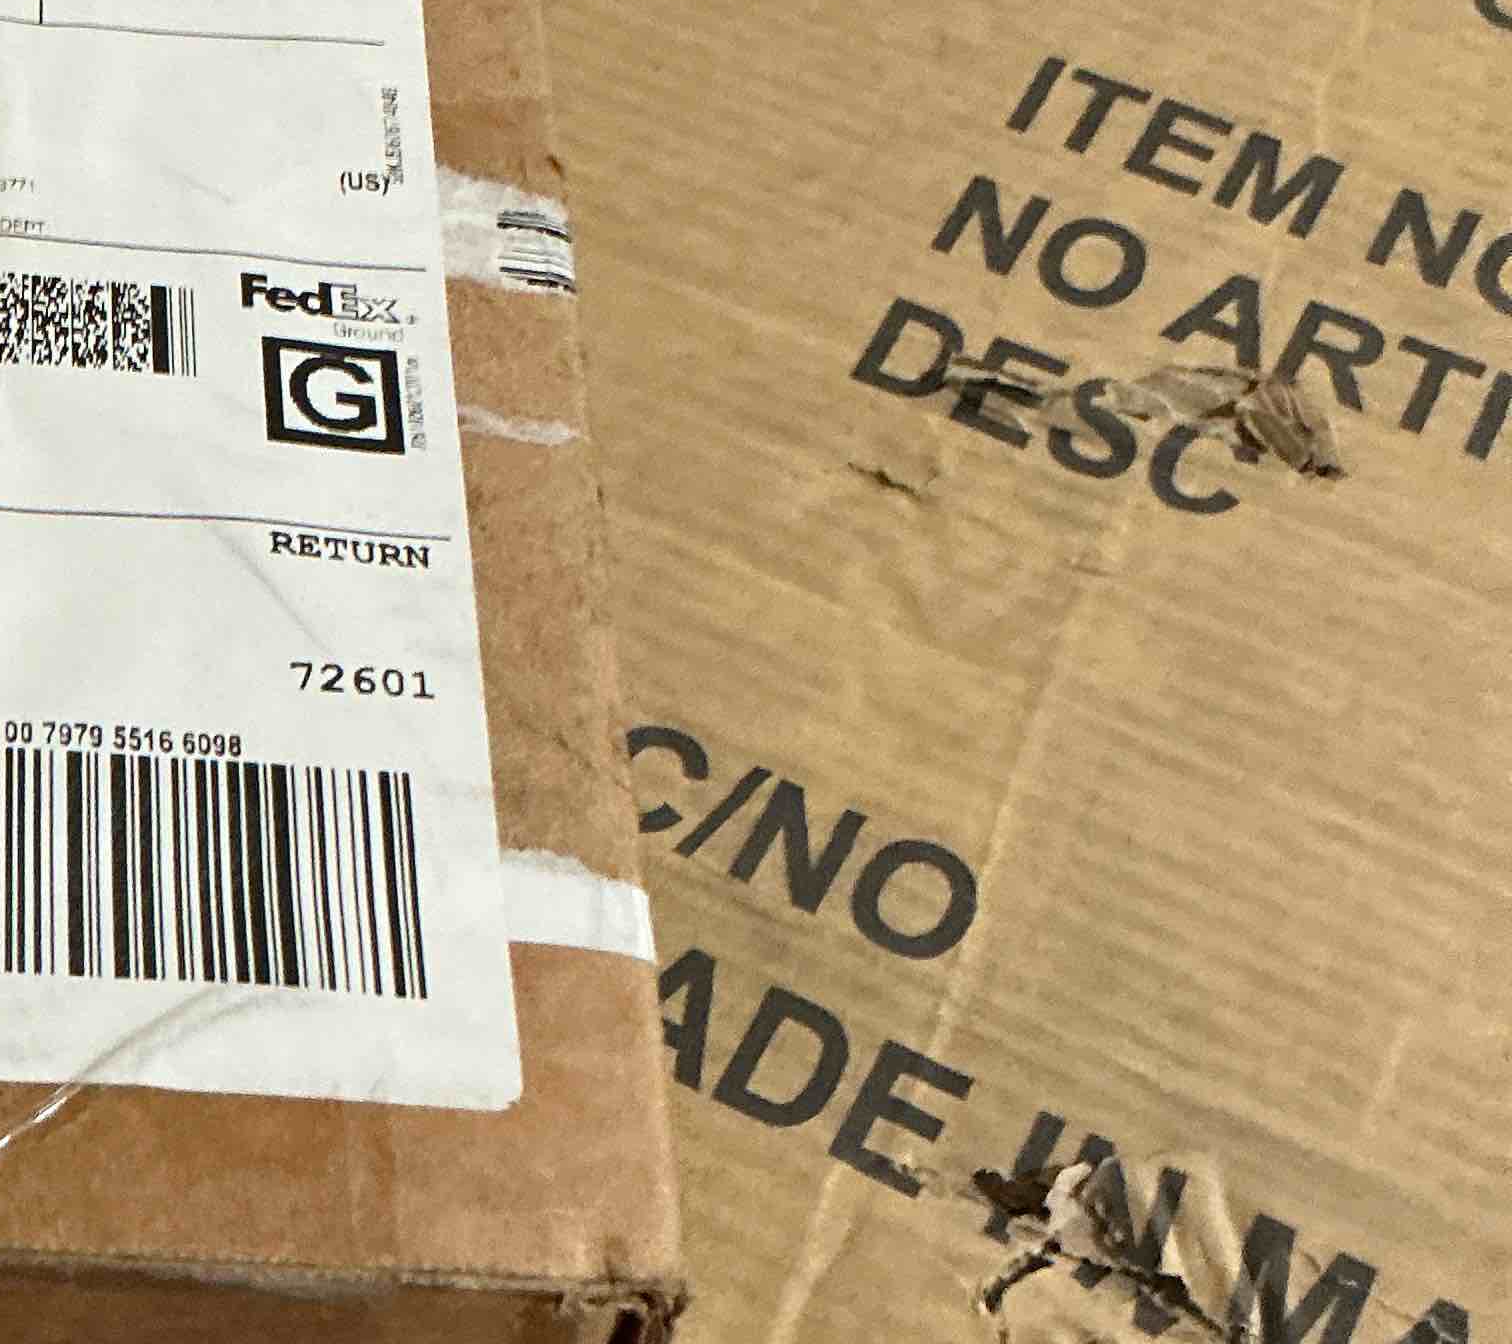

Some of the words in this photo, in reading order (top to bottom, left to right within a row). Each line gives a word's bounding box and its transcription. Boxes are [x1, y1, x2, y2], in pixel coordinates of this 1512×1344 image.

[339, 170, 390, 197] (US)
[1006, 56, 1346, 241] ITEM
[239, 271, 402, 325] FedEx
[931, 174, 1149, 310] NO
[1159, 273, 1512, 462] ARTI
[289, 355, 379, 433] G
[849, 296, 1242, 516] DESC
[268, 529, 432, 569] RETURN
[289, 661, 437, 700] 72601
[4, 720, 34, 744] 00
[41, 720, 104, 748] 7979
[112, 724, 175, 753] 5516
[181, 731, 243, 758] 6098
[625, 725, 980, 960] C/NO
[657, 946, 977, 1199] ADE
